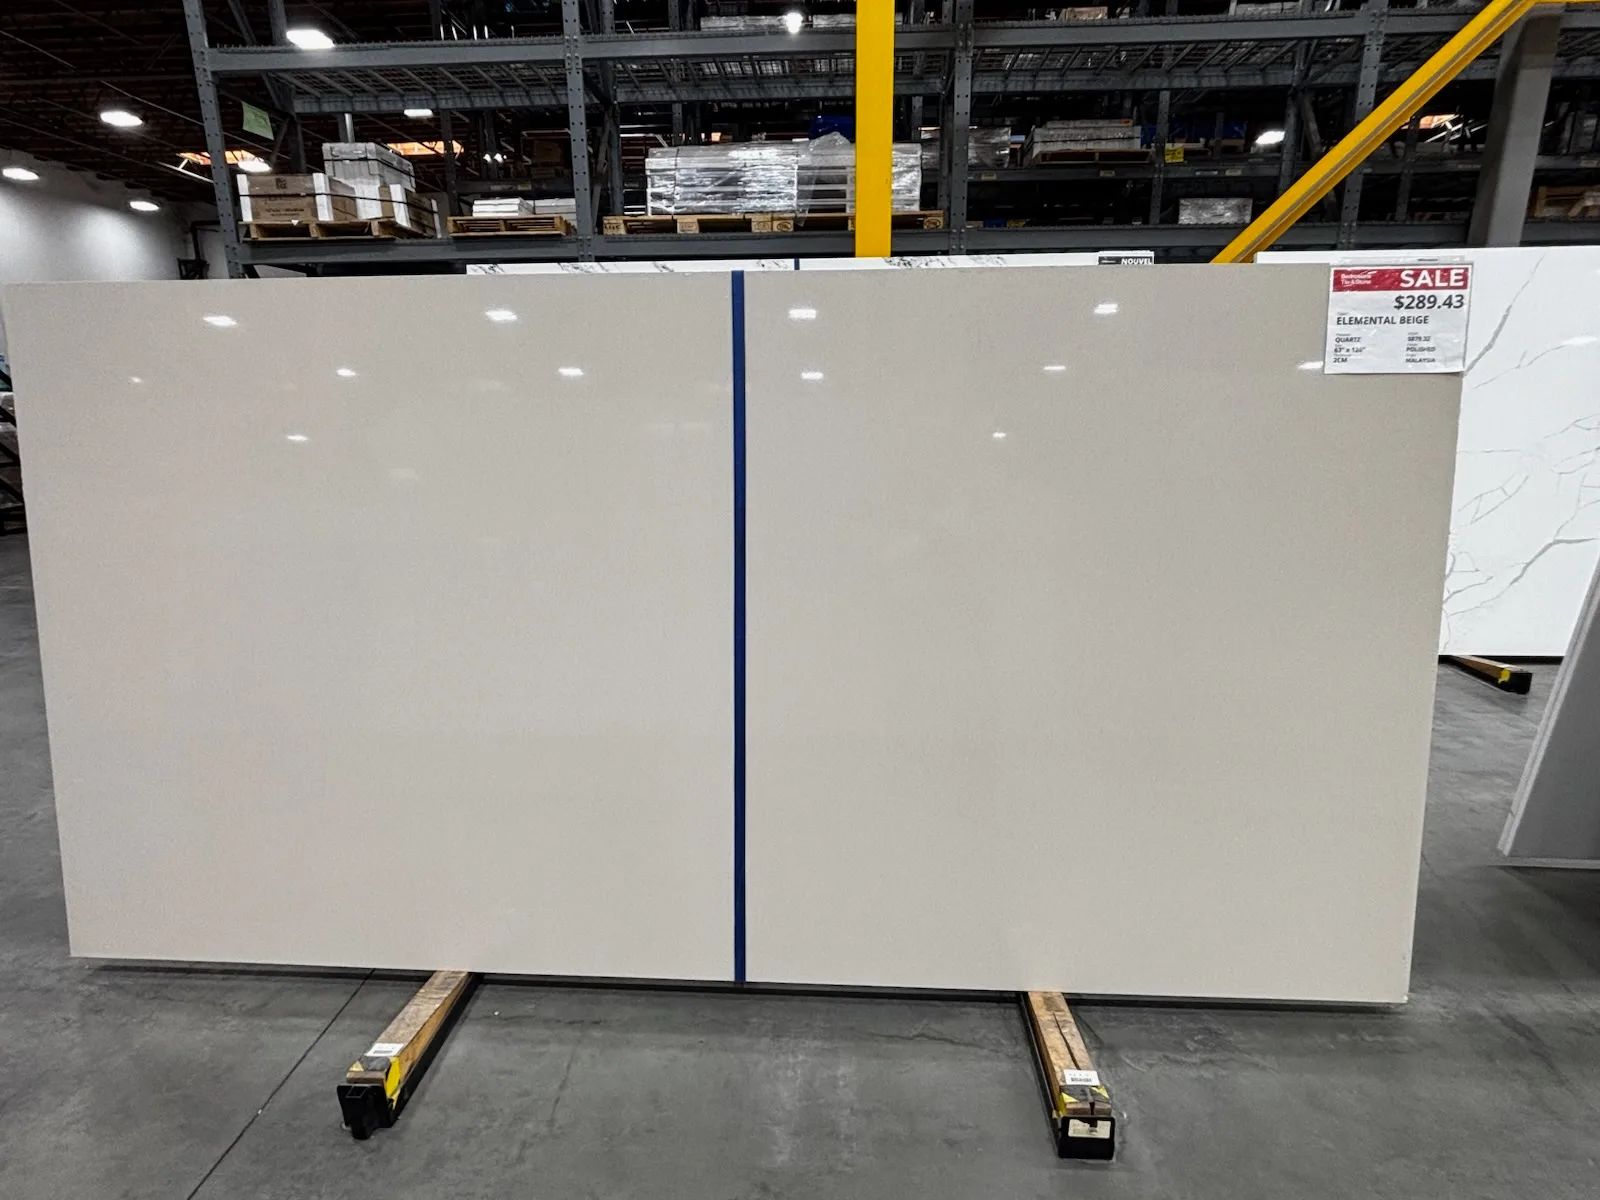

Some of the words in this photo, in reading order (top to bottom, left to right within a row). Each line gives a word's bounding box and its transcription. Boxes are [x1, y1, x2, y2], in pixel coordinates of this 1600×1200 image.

[1400, 269, 1464, 288] SALE
[1394, 294, 1465, 310] $289.43
[1336, 316, 1397, 325] ELEMENTAL
[1399, 315, 1430, 325] BEIGE
